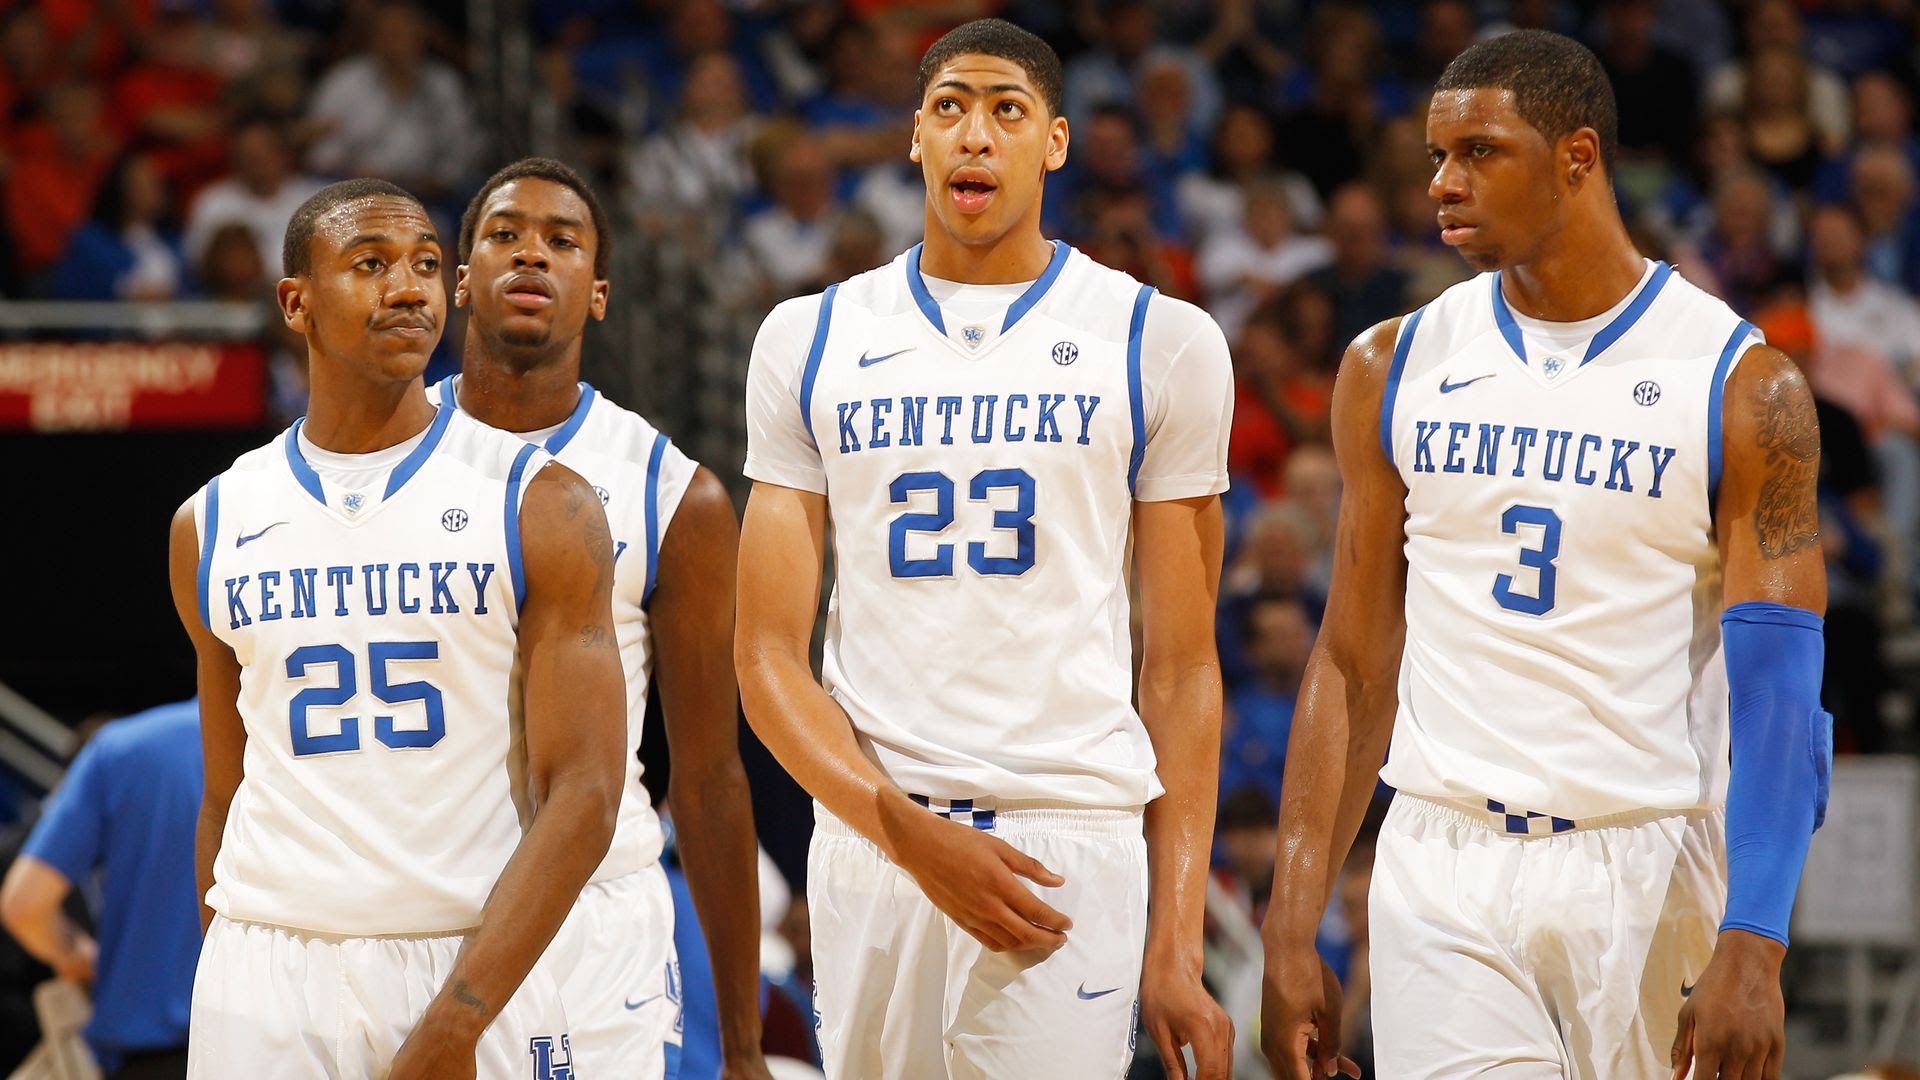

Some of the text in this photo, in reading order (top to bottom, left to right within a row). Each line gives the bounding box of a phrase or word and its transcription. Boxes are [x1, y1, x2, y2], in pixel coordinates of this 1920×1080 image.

[1051, 341, 1079, 366] SEC
[838, 394, 1100, 453] KENTUCKY
[1633, 380, 1661, 406] SEC
[1414, 421, 1676, 498] KENTUCKY
[441, 508, 469, 532] SEC
[889, 468, 1036, 577] 23
[1491, 504, 1562, 615] 3
[225, 562, 494, 629] KENTUCKY
[285, 641, 446, 756] 25
